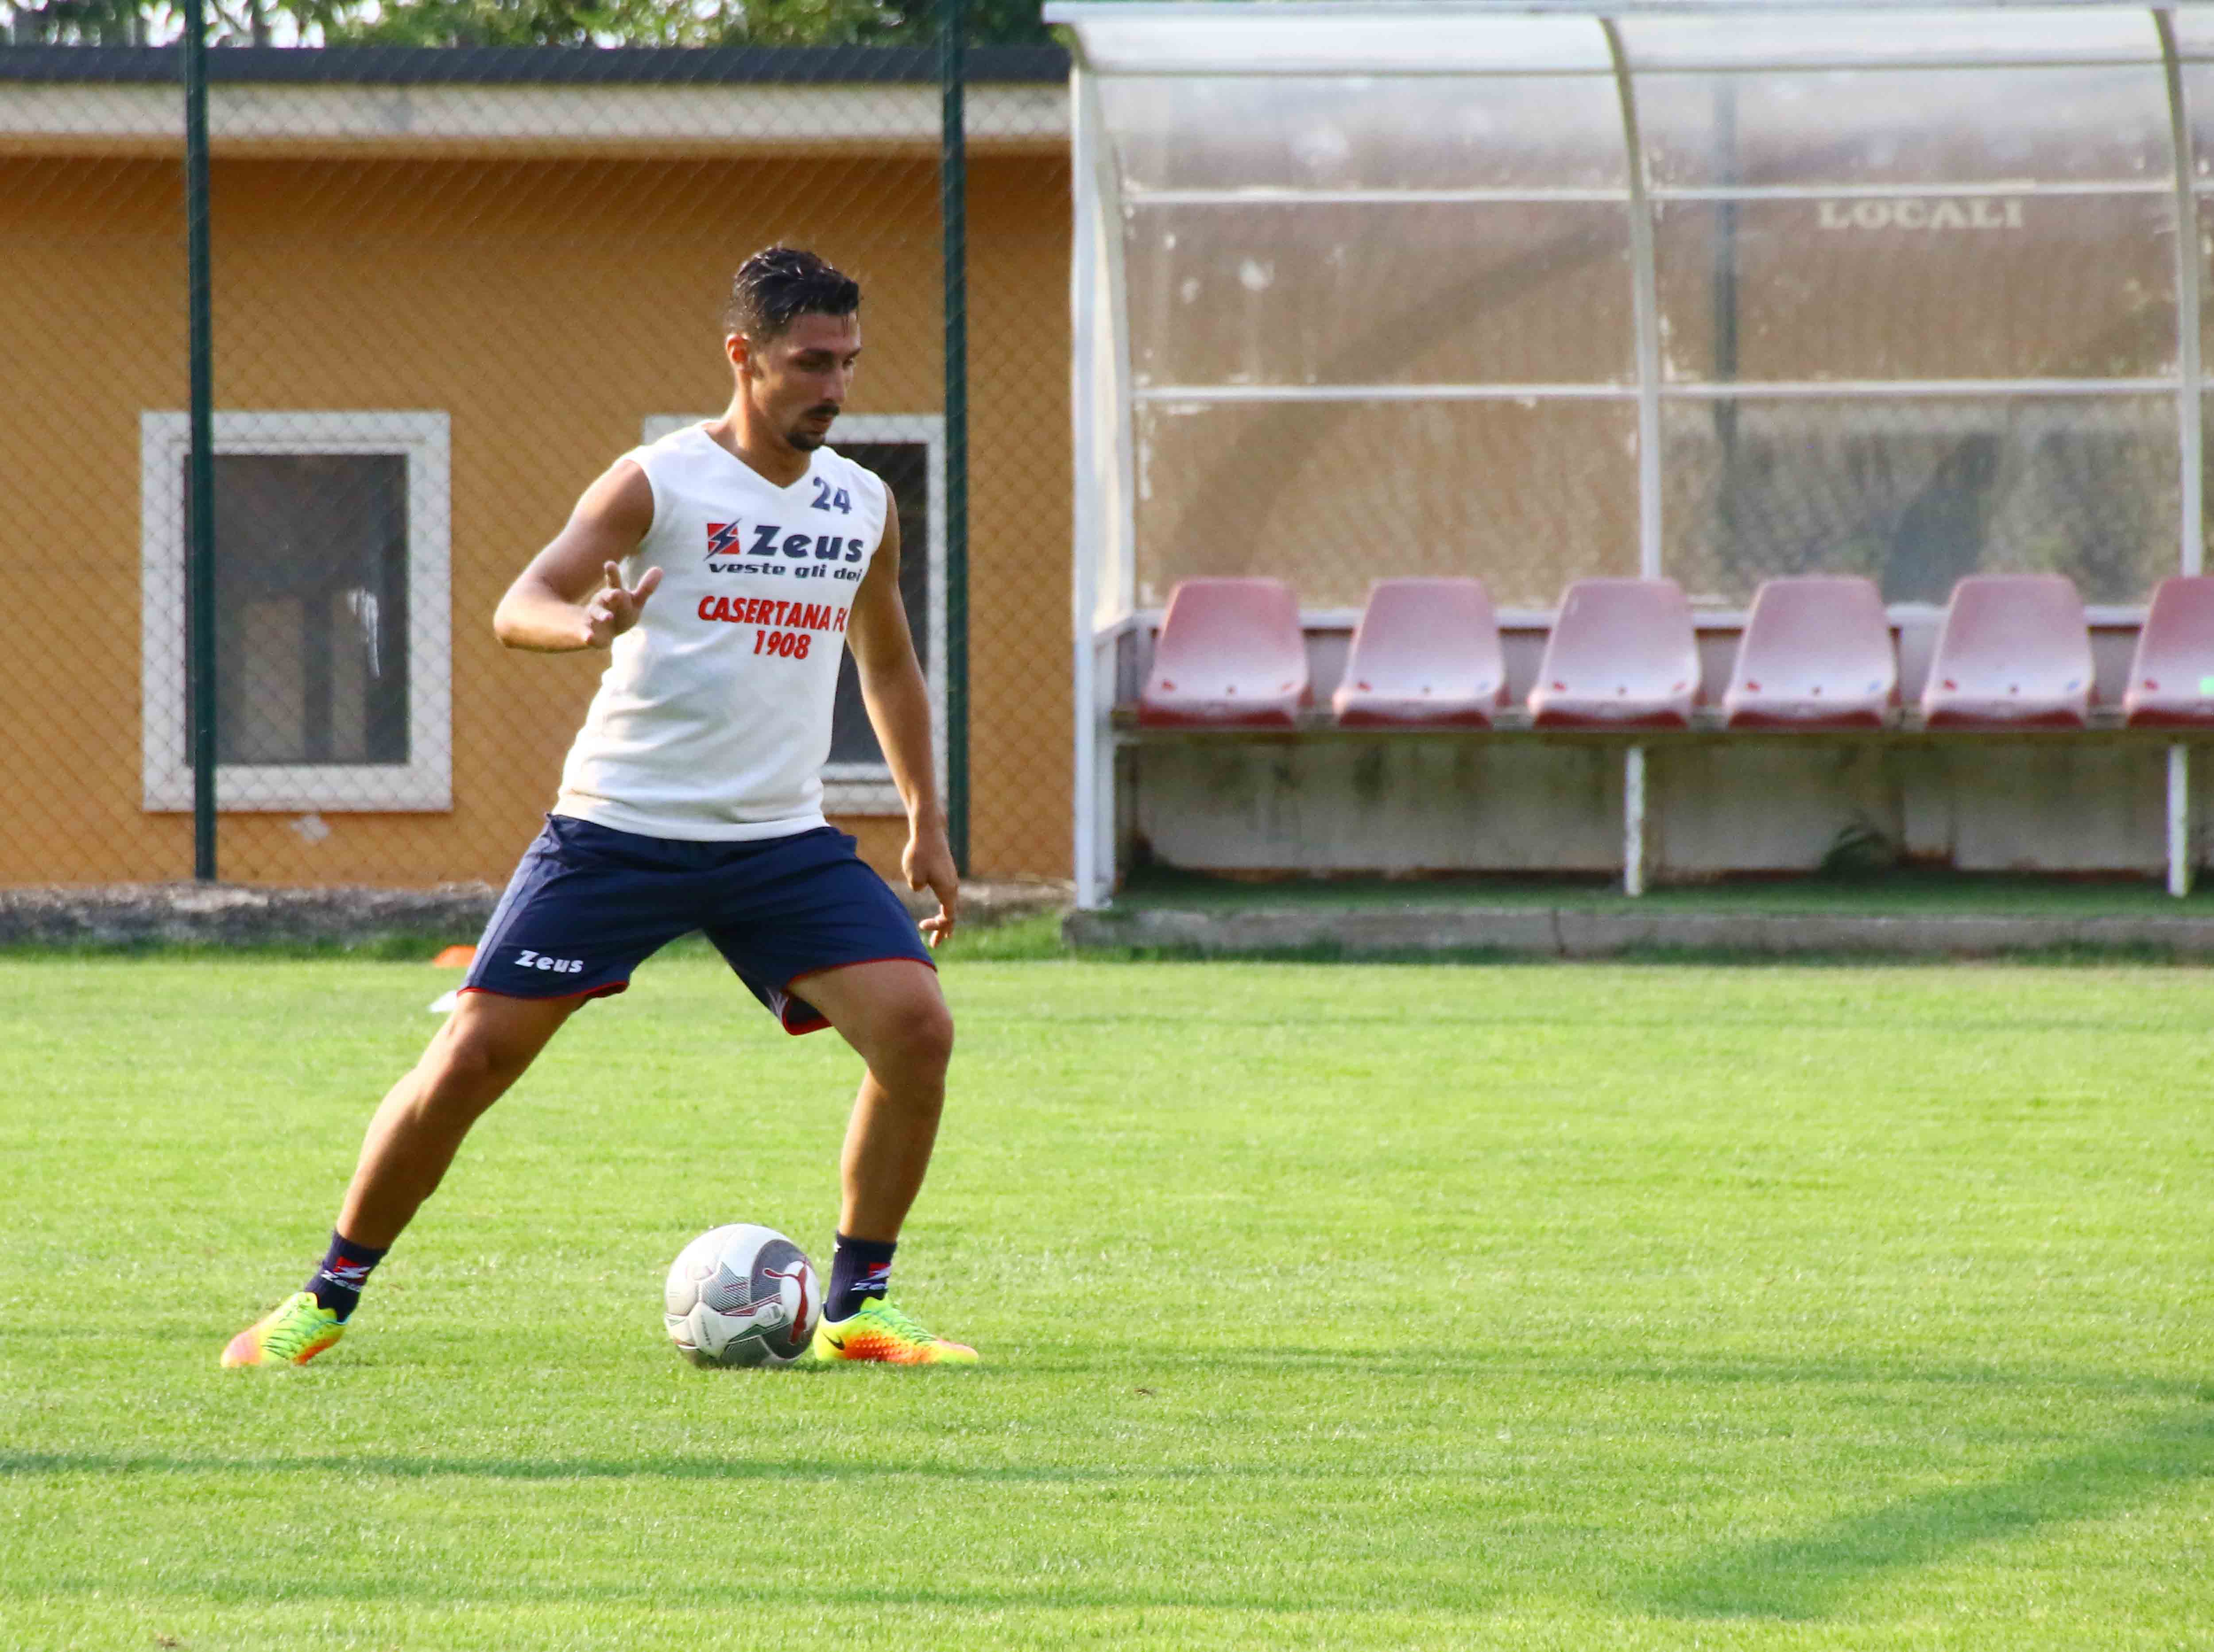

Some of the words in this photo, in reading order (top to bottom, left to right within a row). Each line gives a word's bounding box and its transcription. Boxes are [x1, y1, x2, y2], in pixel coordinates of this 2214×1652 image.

[1818, 198, 2024, 229] LOCALI
[810, 476, 852, 514] 24
[747, 525, 863, 562] Zeus
[708, 563, 786, 575] veste
[795, 564, 826, 578] gli
[834, 568, 863, 582] dei
[698, 596, 832, 631] CASERTANA
[754, 630, 811, 659] 1908
[514, 950, 584, 973] Zeus
